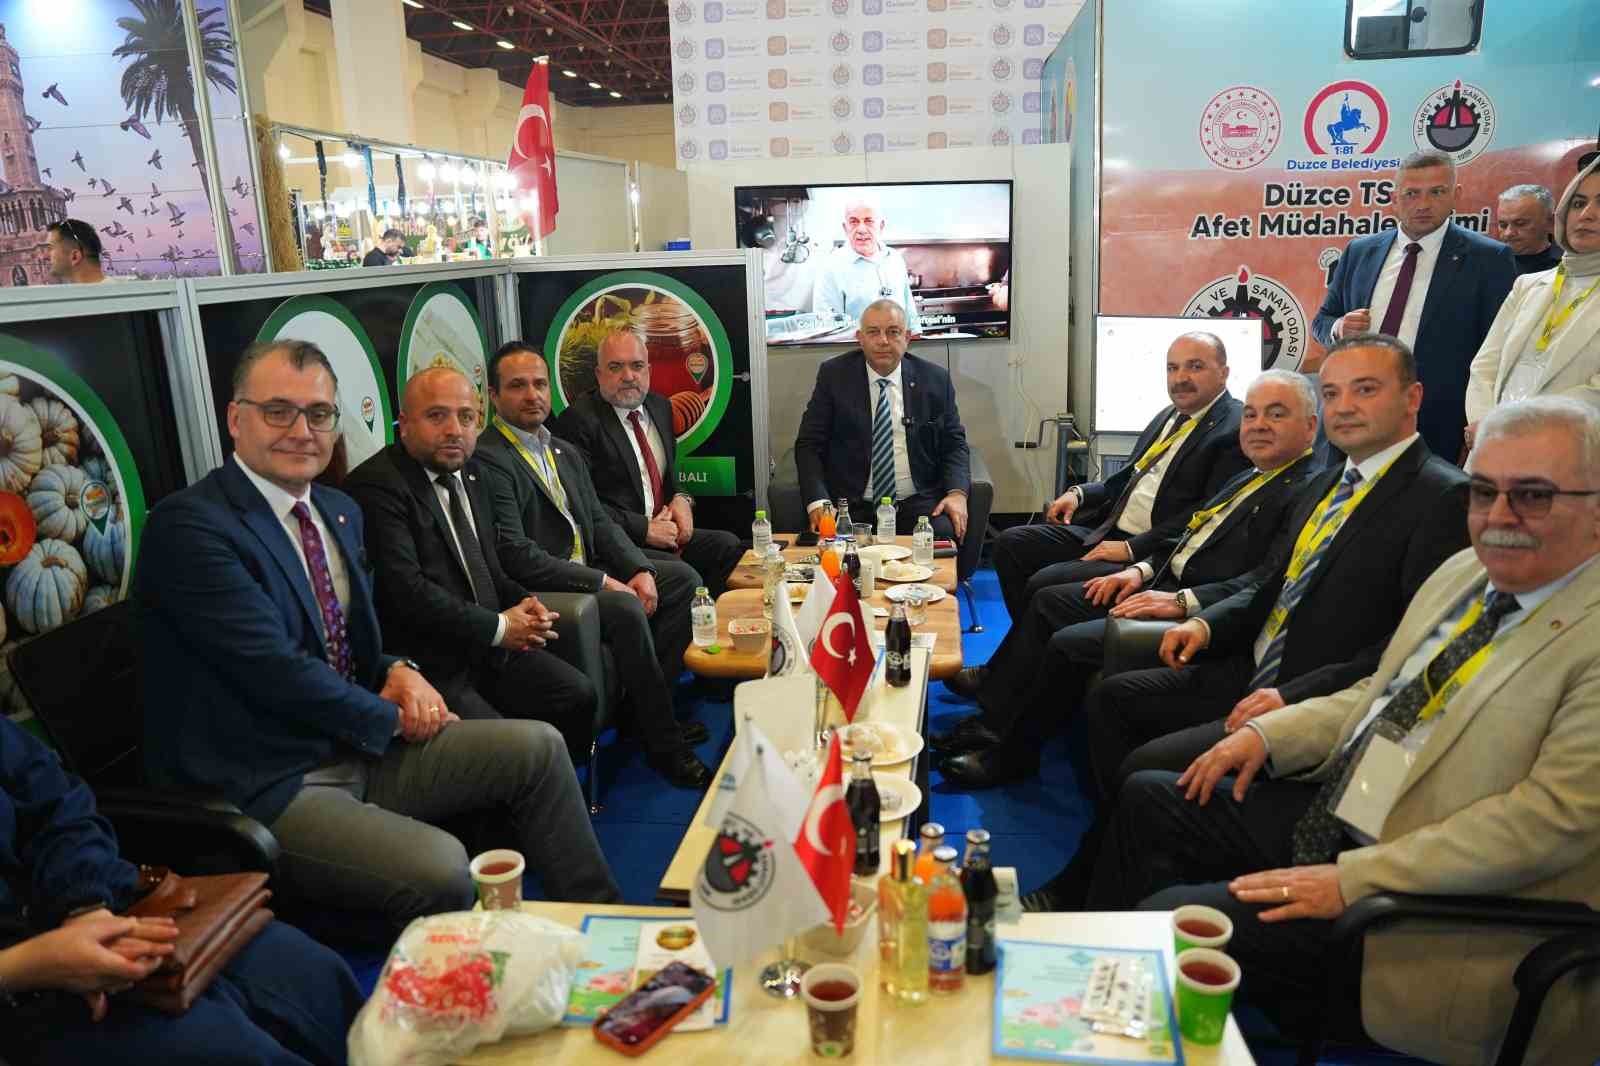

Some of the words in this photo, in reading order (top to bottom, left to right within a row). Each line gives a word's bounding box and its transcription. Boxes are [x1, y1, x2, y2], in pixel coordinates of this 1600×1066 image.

[1332, 159, 1400, 170] Belediyesi
[1265, 183, 1350, 206] Düzce
[1192, 215, 1250, 238] Afet
[1260, 213, 1398, 236] Müdahale
[1210, 287, 1228, 300] VE
[1251, 285, 1292, 316] SANAYİ
[1286, 317, 1299, 357] ODASI
[678, 472, 708, 482] BALI
